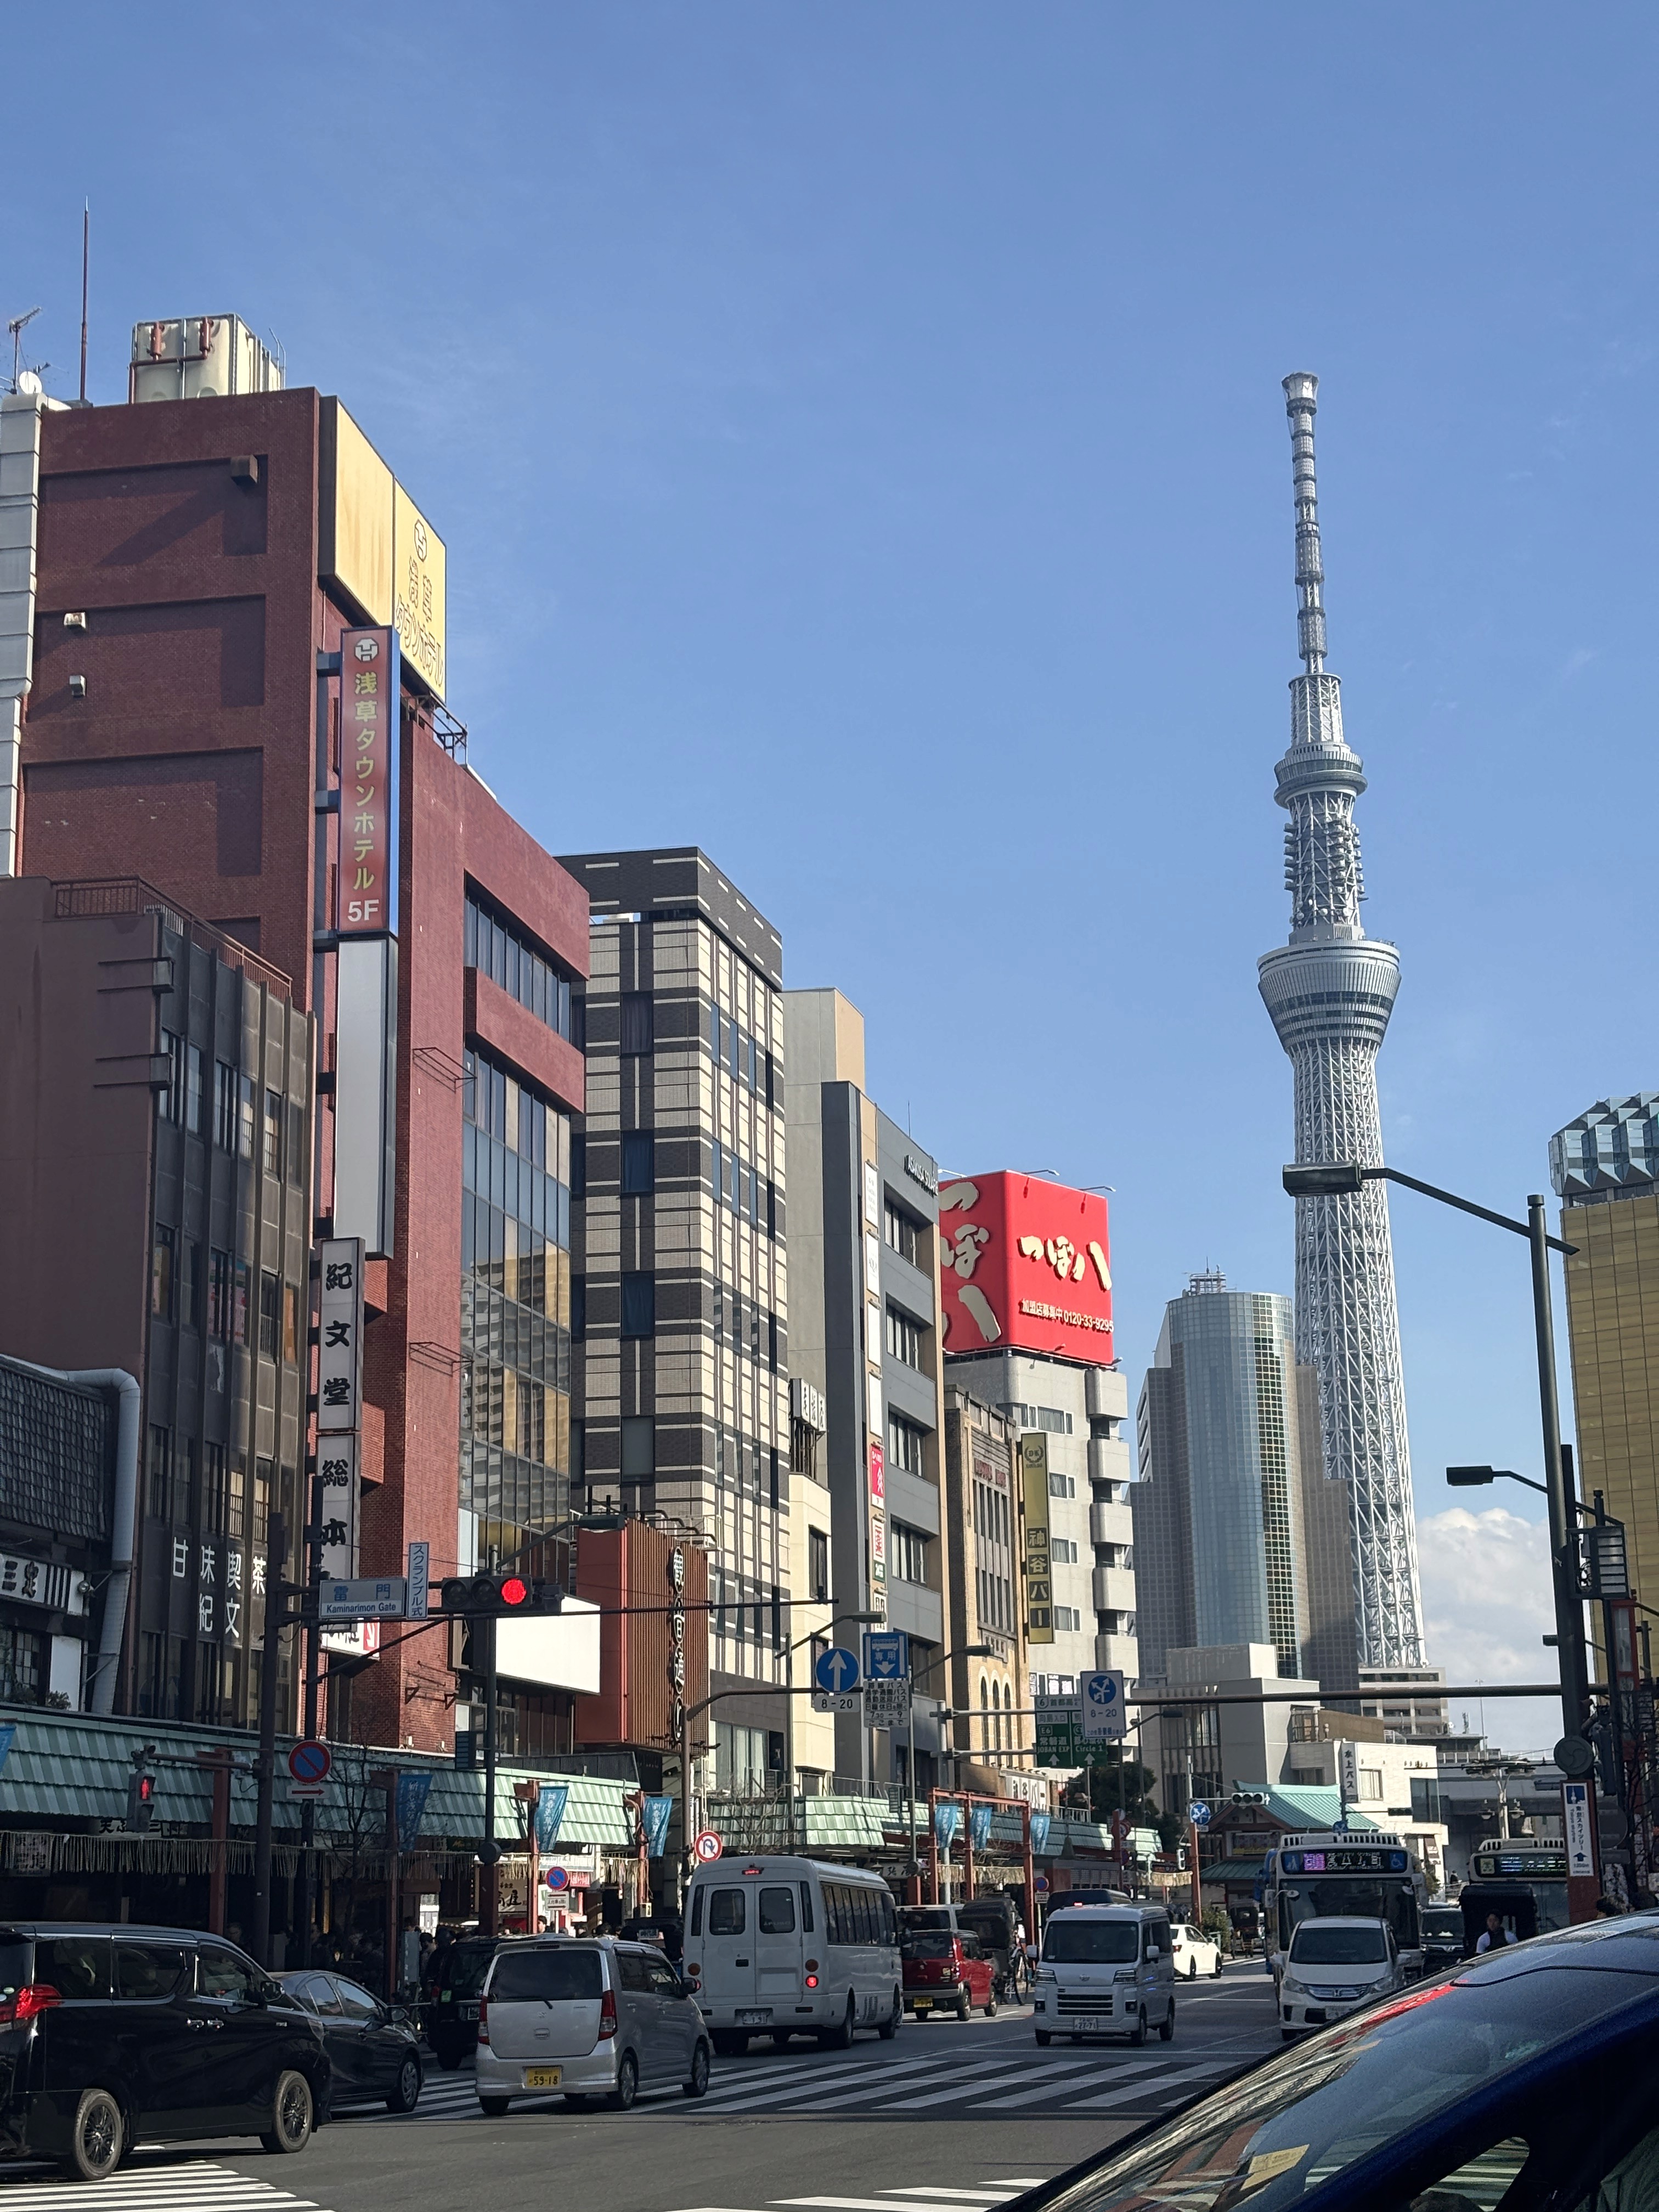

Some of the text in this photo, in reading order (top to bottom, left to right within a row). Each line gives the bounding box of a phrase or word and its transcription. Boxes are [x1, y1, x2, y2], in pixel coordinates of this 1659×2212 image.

[353, 671, 377, 891] 浅草タウンホテル
[347, 899, 380, 922] 5F
[1019, 1234, 1113, 1291] つぼ八
[1063, 1310, 1114, 1333] 0120-33-9295
[411, 1545, 425, 1616] スクランブル式
[1028, 1528, 1049, 1626] 神谷バー
[334, 1584, 391, 1601] 雷門
[326, 1602, 396, 1614] Kaminarimon Gate
[874, 1651, 896, 1661] 専用
[1040, 1697, 1045, 1706] 6
[1344, 1750, 1354, 1788] 水上バス
[533, 2075, 558, 2086] 59-18
